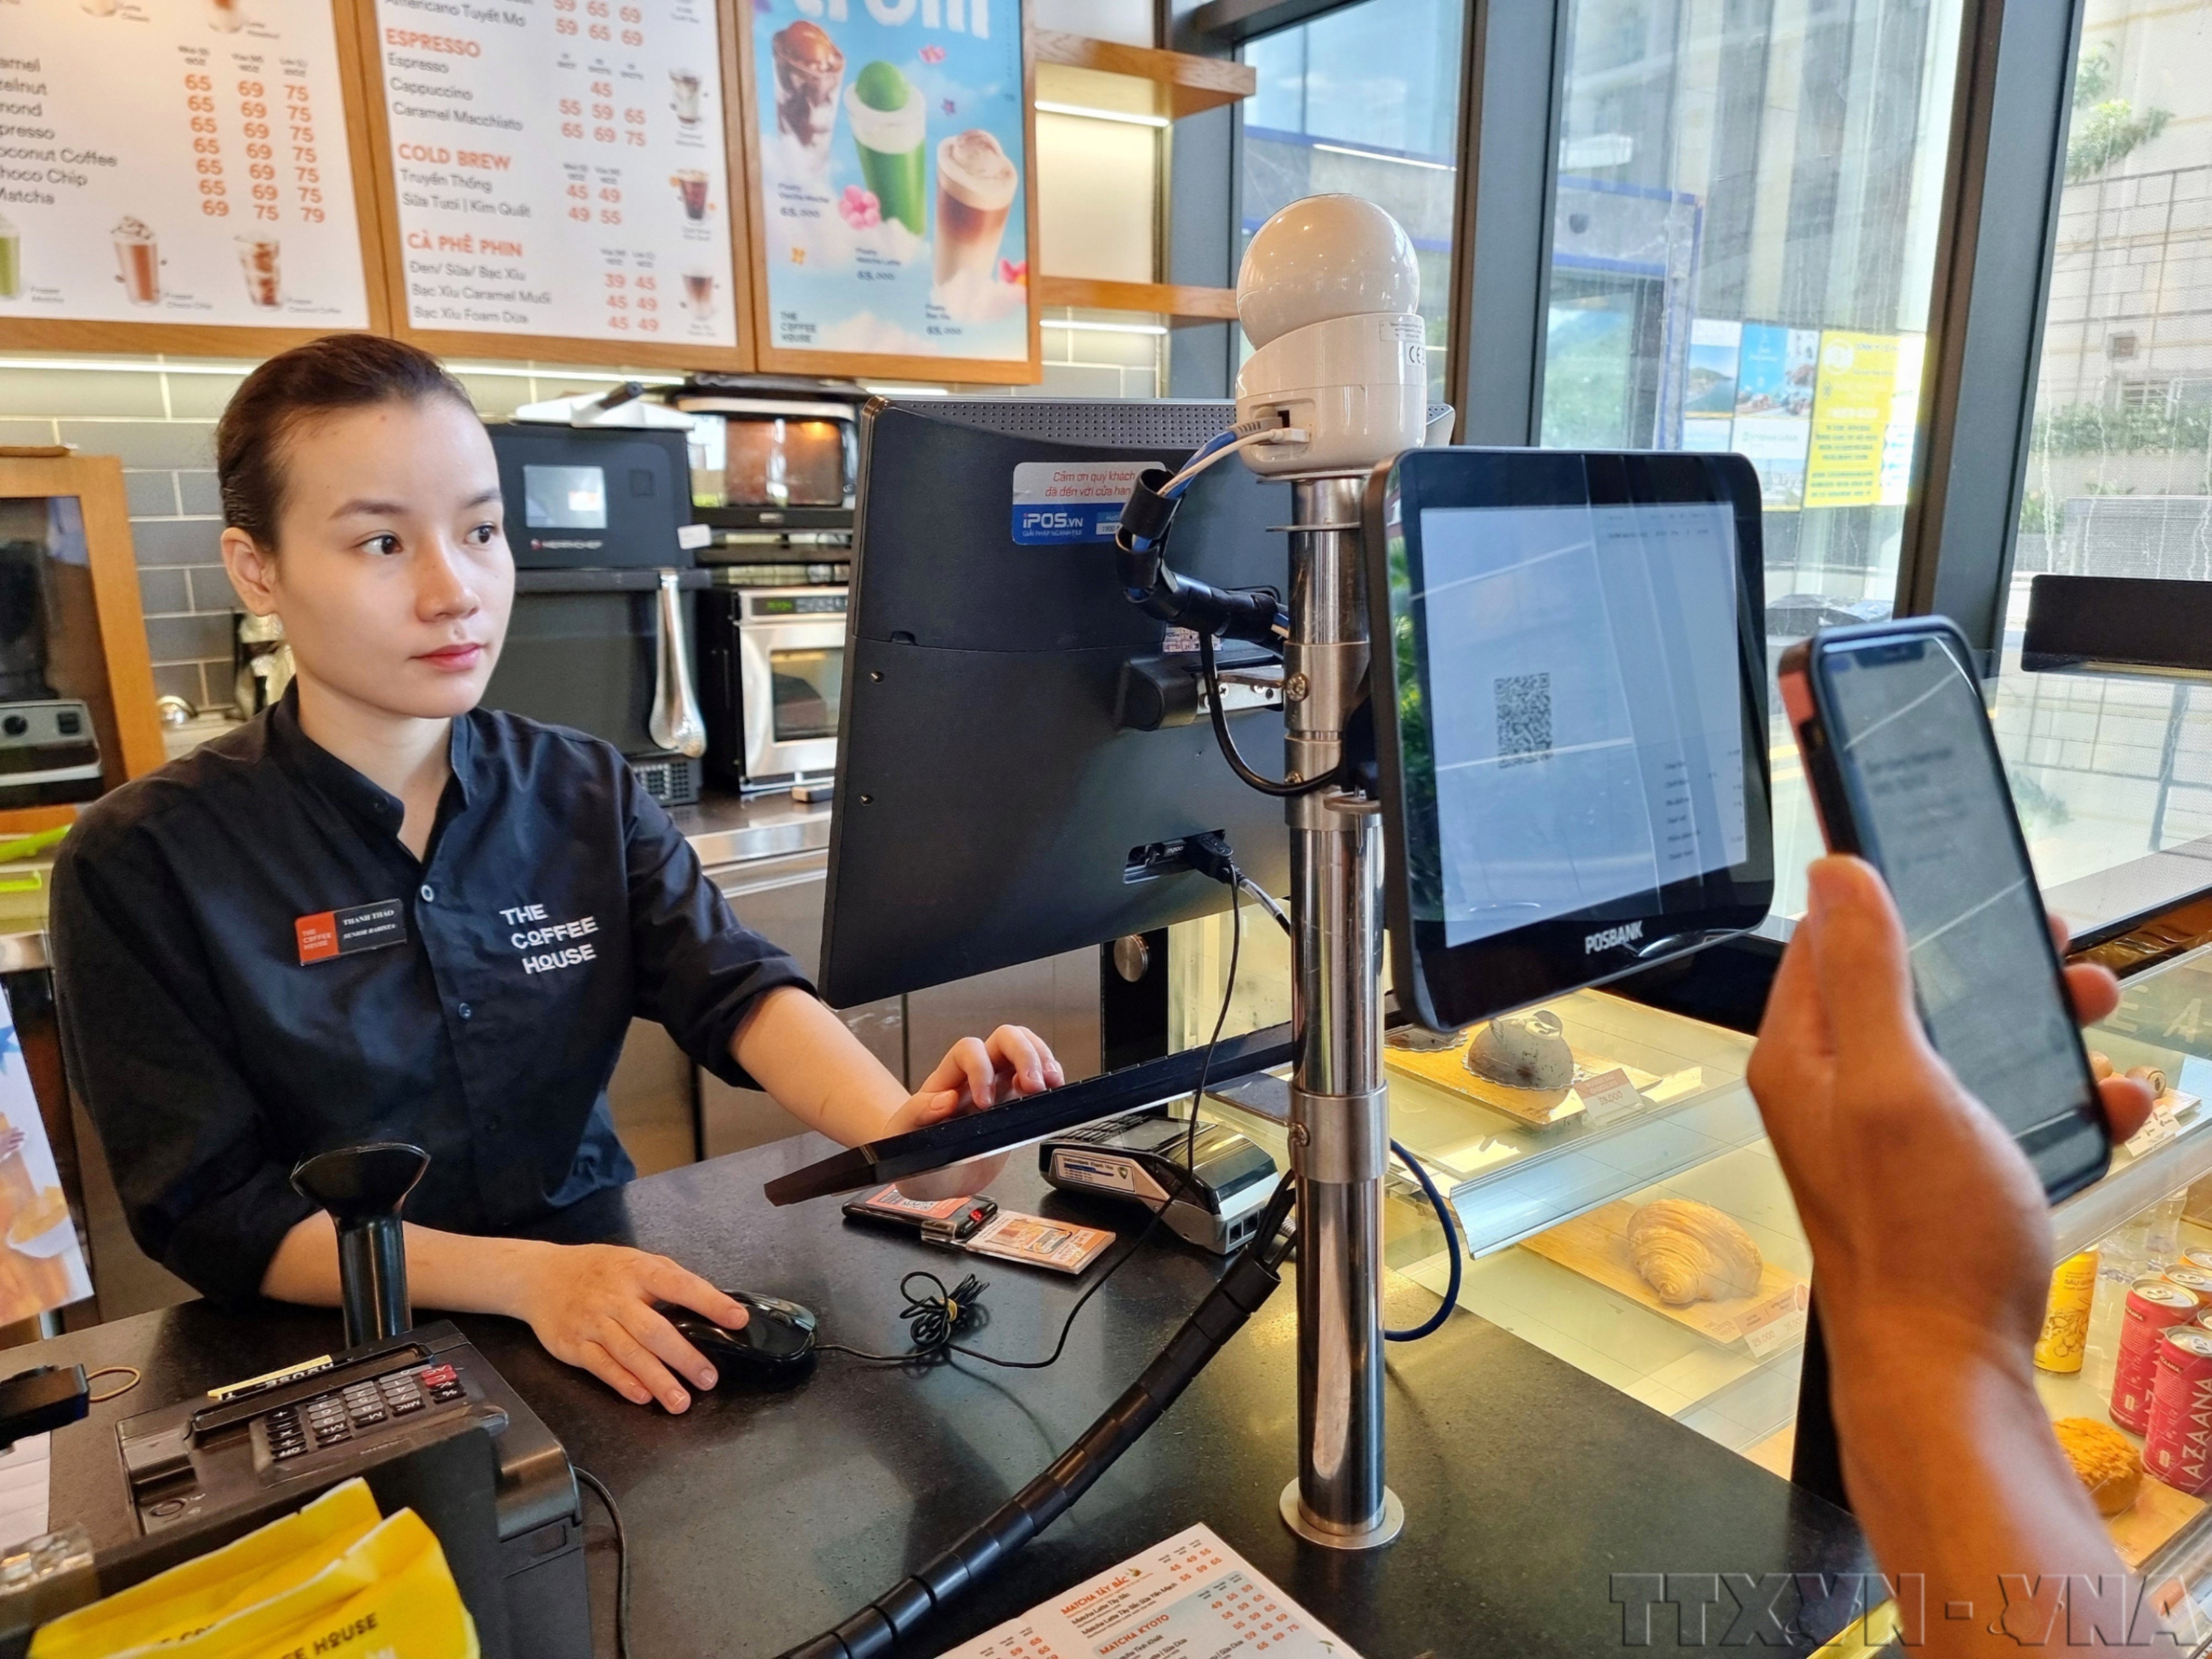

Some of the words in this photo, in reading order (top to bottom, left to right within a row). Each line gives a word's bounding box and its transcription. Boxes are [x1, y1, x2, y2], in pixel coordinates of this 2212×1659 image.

[385, 28, 481, 59] ESPRESSO
[387, 52, 449, 74] Espresso
[185, 74, 213, 92] 65
[238, 80, 264, 98] 69
[283, 85, 309, 102] 75
[389, 77, 474, 101] Cappuccino
[187, 95, 215, 113] 65
[241, 101, 267, 119] 69
[286, 105, 312, 123] 75
[392, 101, 450, 121] Caramel
[453, 109, 524, 131] Macchiato
[190, 116, 218, 134] 65
[243, 122, 270, 139] 69
[289, 125, 315, 143] 75
[60, 147, 118, 167] Coffee
[193, 137, 221, 155] 65
[246, 143, 272, 160] 69
[292, 146, 317, 163] 75
[398, 144, 450, 164] COLD
[456, 150, 511, 171] BREW
[46, 168, 88, 188] Chip
[196, 158, 224, 176] 65
[249, 164, 275, 181] 69
[294, 166, 320, 184] 75
[199, 179, 226, 196] 65
[252, 184, 278, 201] 69
[297, 186, 323, 204] 75
[202, 199, 230, 217] 69
[253, 204, 280, 221] 75
[300, 206, 325, 224] 79
[471, 201, 497, 215] Kim
[408, 229, 432, 250] CÀ
[438, 233, 474, 254] PHÊ
[480, 240, 523, 257] PHIN
[461, 287, 516, 302] Caramel
[1023, 513, 1083, 528] iPOS.VN
[343, 913, 370, 926] THANH
[499, 903, 548, 925] THE
[511, 916, 599, 949] COFFEE
[1585, 920, 1643, 955] POSBANK
[522, 943, 597, 974] HOUSE
[1170, 1563, 1181, 1572] 45
[1186, 1555, 1198, 1563] 49
[1060, 1594, 1096, 1615] MATCHA
[1211, 1600, 1223, 1609] 49
[1071, 1611, 1095, 1625] Matcha
[1081, 1621, 1105, 1635] Matcha
[314, 1612, 378, 1656] HOUSE
[1099, 1632, 1138, 1656] MATCHA
[1137, 1614, 1169, 1635] KYOTO
